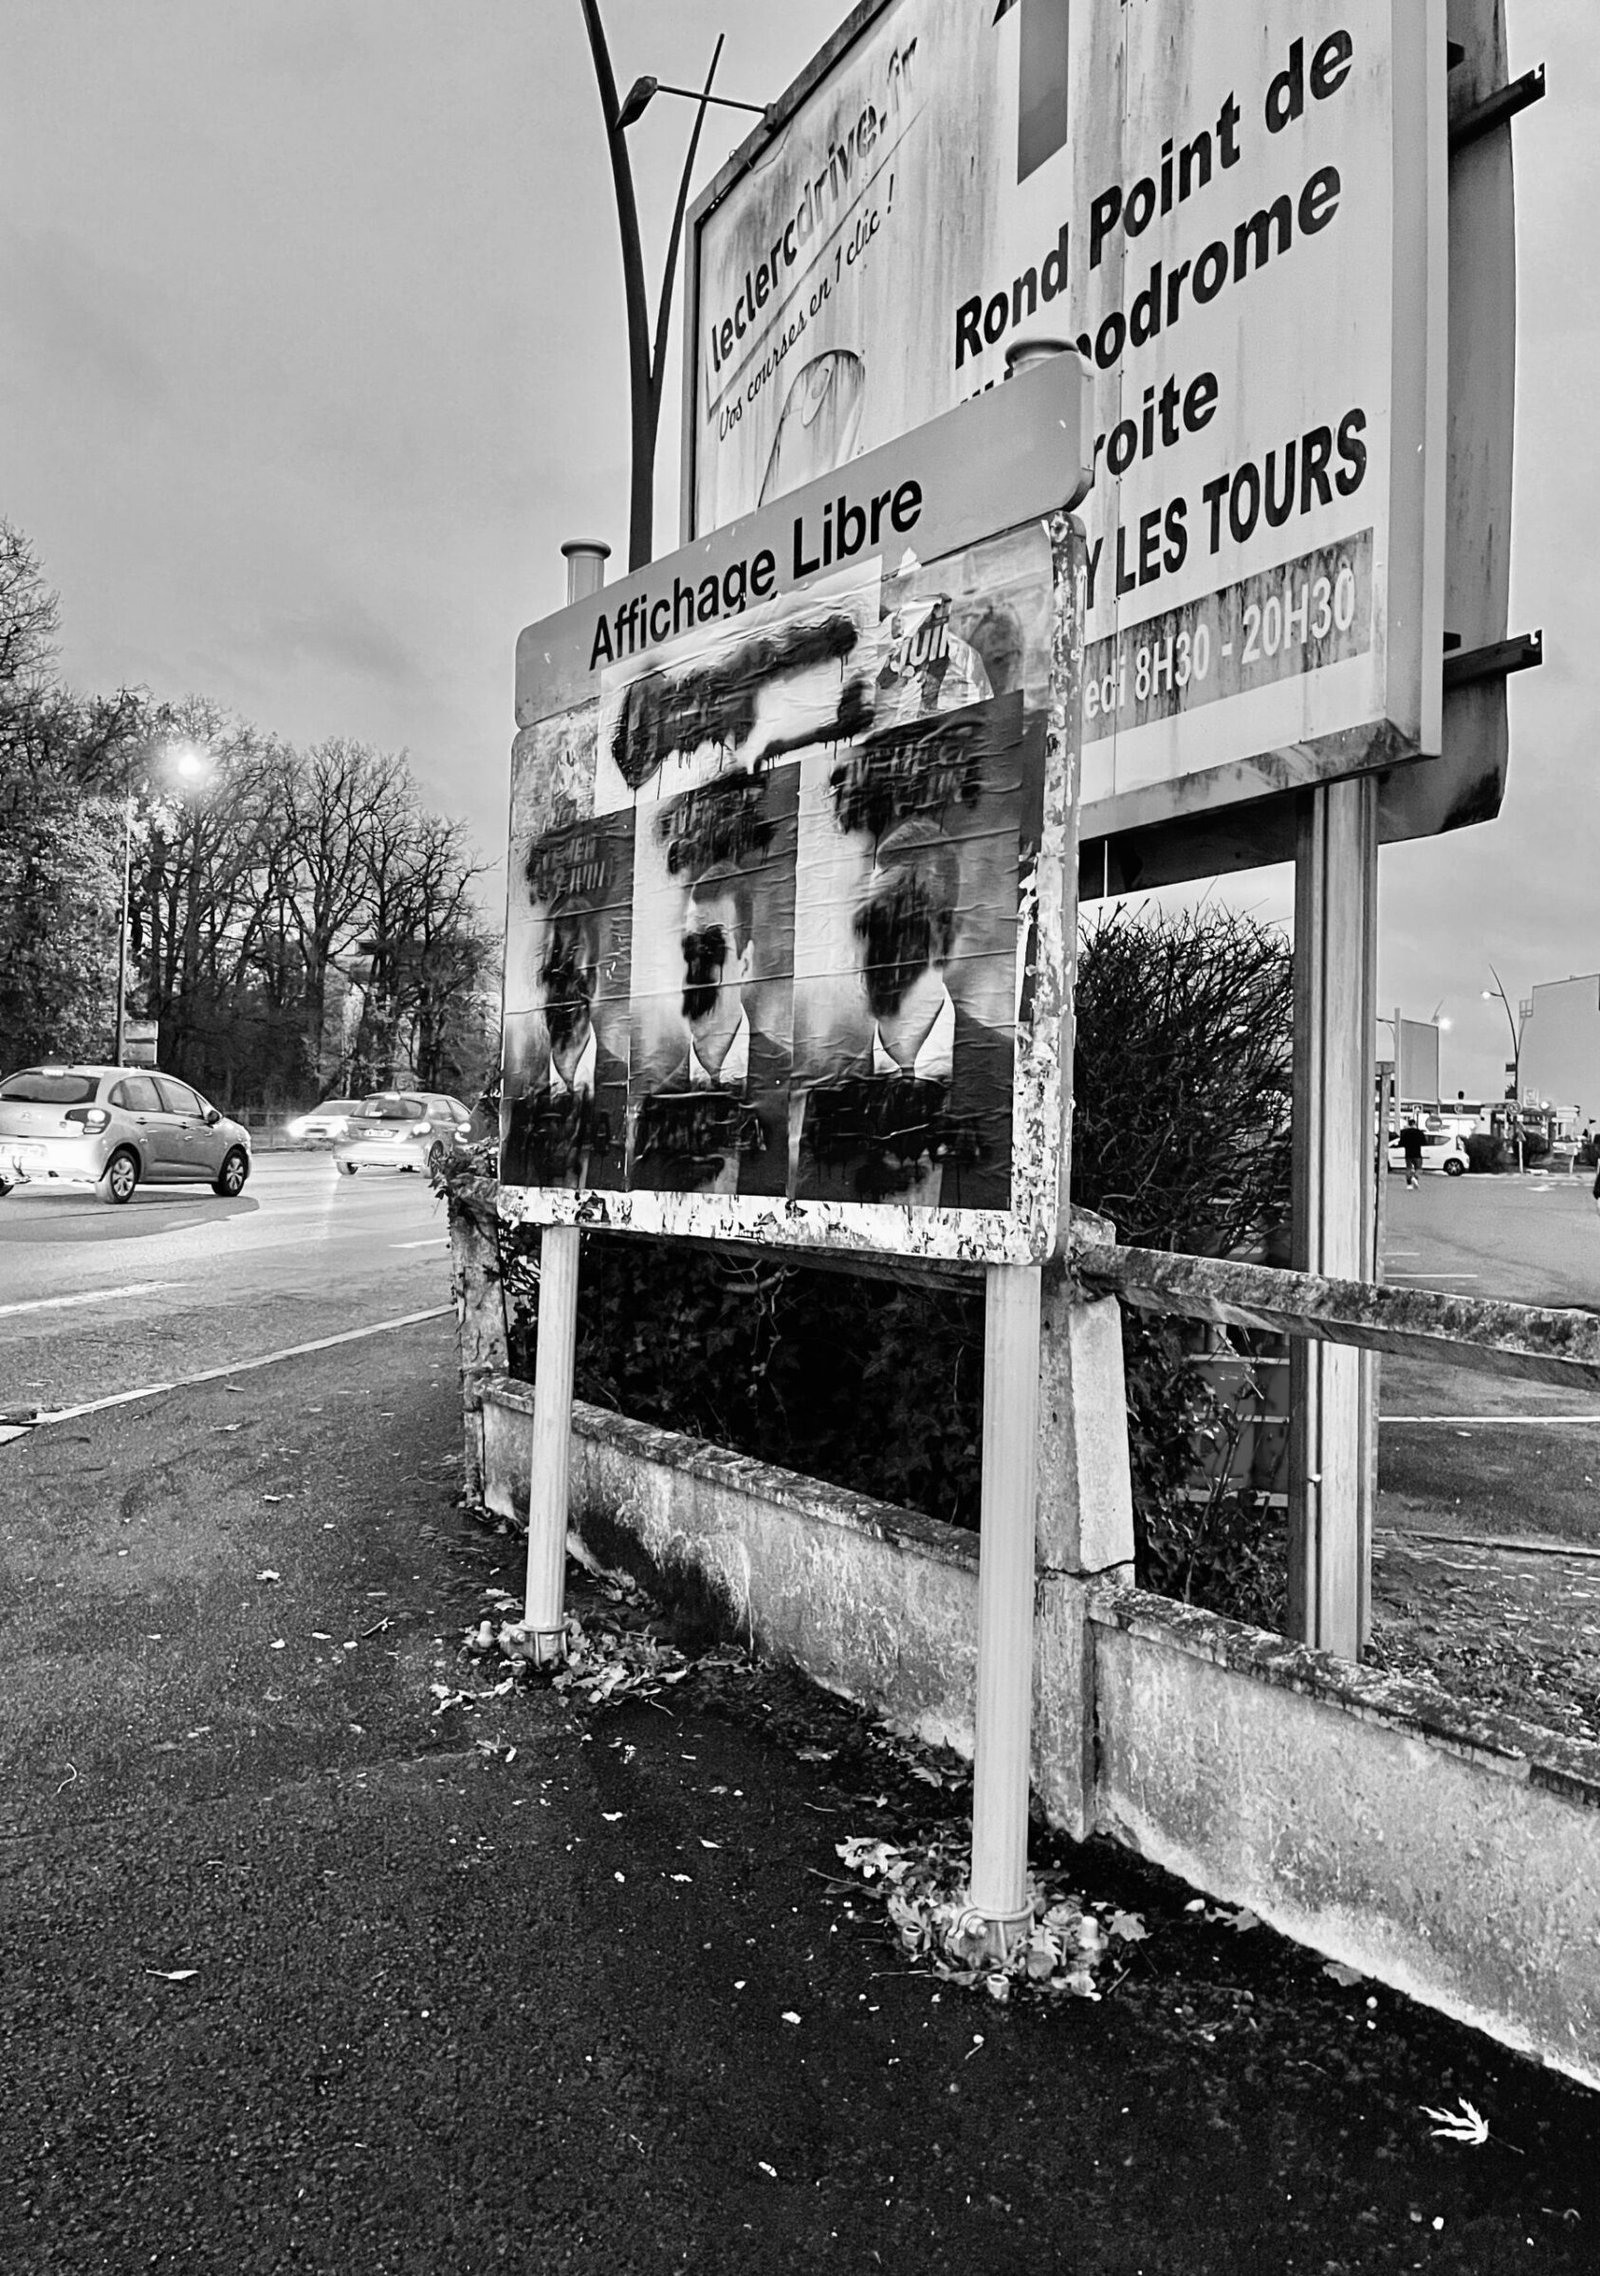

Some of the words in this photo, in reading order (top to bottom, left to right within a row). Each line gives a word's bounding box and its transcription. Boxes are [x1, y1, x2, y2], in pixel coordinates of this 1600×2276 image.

[710, 36, 918, 373] leclercdrive.fr
[955, 221, 1069, 371] Rond
[1090, 89, 1241, 271] Point
[1264, 29, 1354, 134] de
[1076, 165, 1342, 370] odrome
[719, 396, 743, 442] Vos
[747, 309, 808, 402] courses
[810, 277, 832, 318] en
[834, 244, 842, 283] 1
[846, 207, 882, 266] clic
[1094, 372, 1219, 476] roite
[1115, 496, 1188, 597] LES
[1202, 407, 1368, 555] TOURS
[589, 549, 776, 671] Affichage
[793, 480, 923, 580] Libre
[1084, 654, 1127, 719] edi
[1135, 622, 1210, 701] 8H30
[1241, 566, 1355, 665] 20H30
